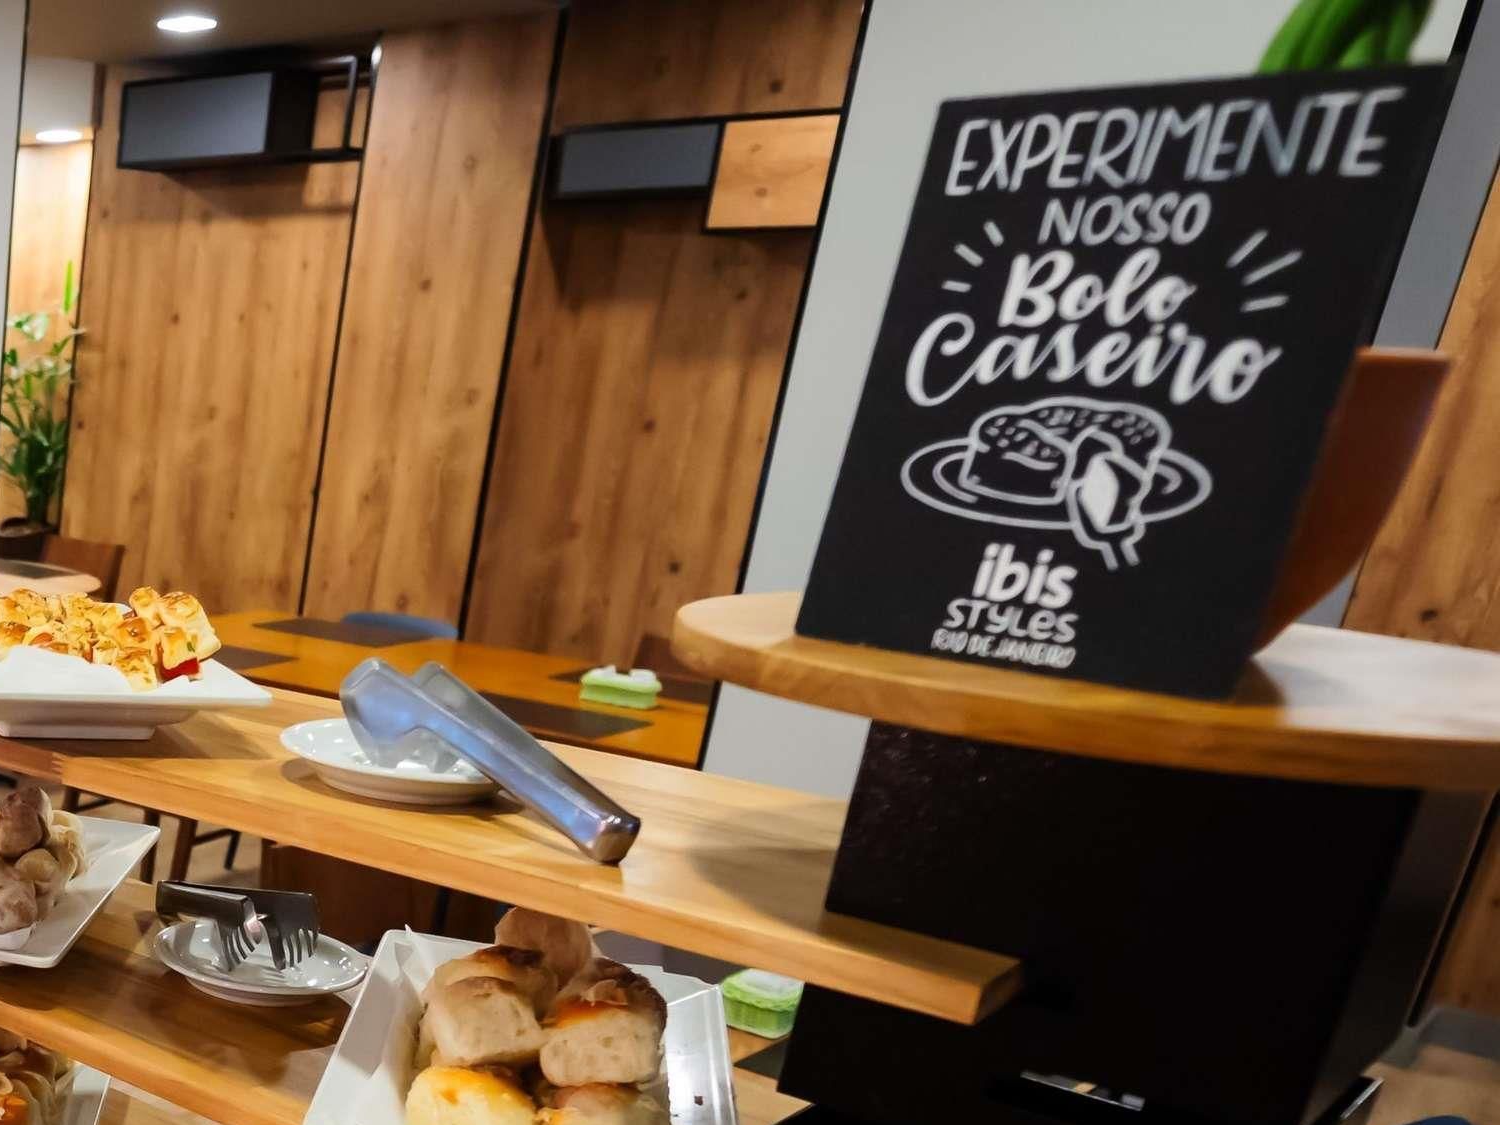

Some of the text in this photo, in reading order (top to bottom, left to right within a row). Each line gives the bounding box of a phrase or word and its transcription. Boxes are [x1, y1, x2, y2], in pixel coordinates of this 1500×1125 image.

[944, 86, 1407, 196] EXPERIMENTE
[1037, 193, 1211, 246] NOSSO
[999, 247, 1197, 328] Bolo
[905, 312, 1282, 407] Caseiro
[971, 542, 1078, 610] ibis
